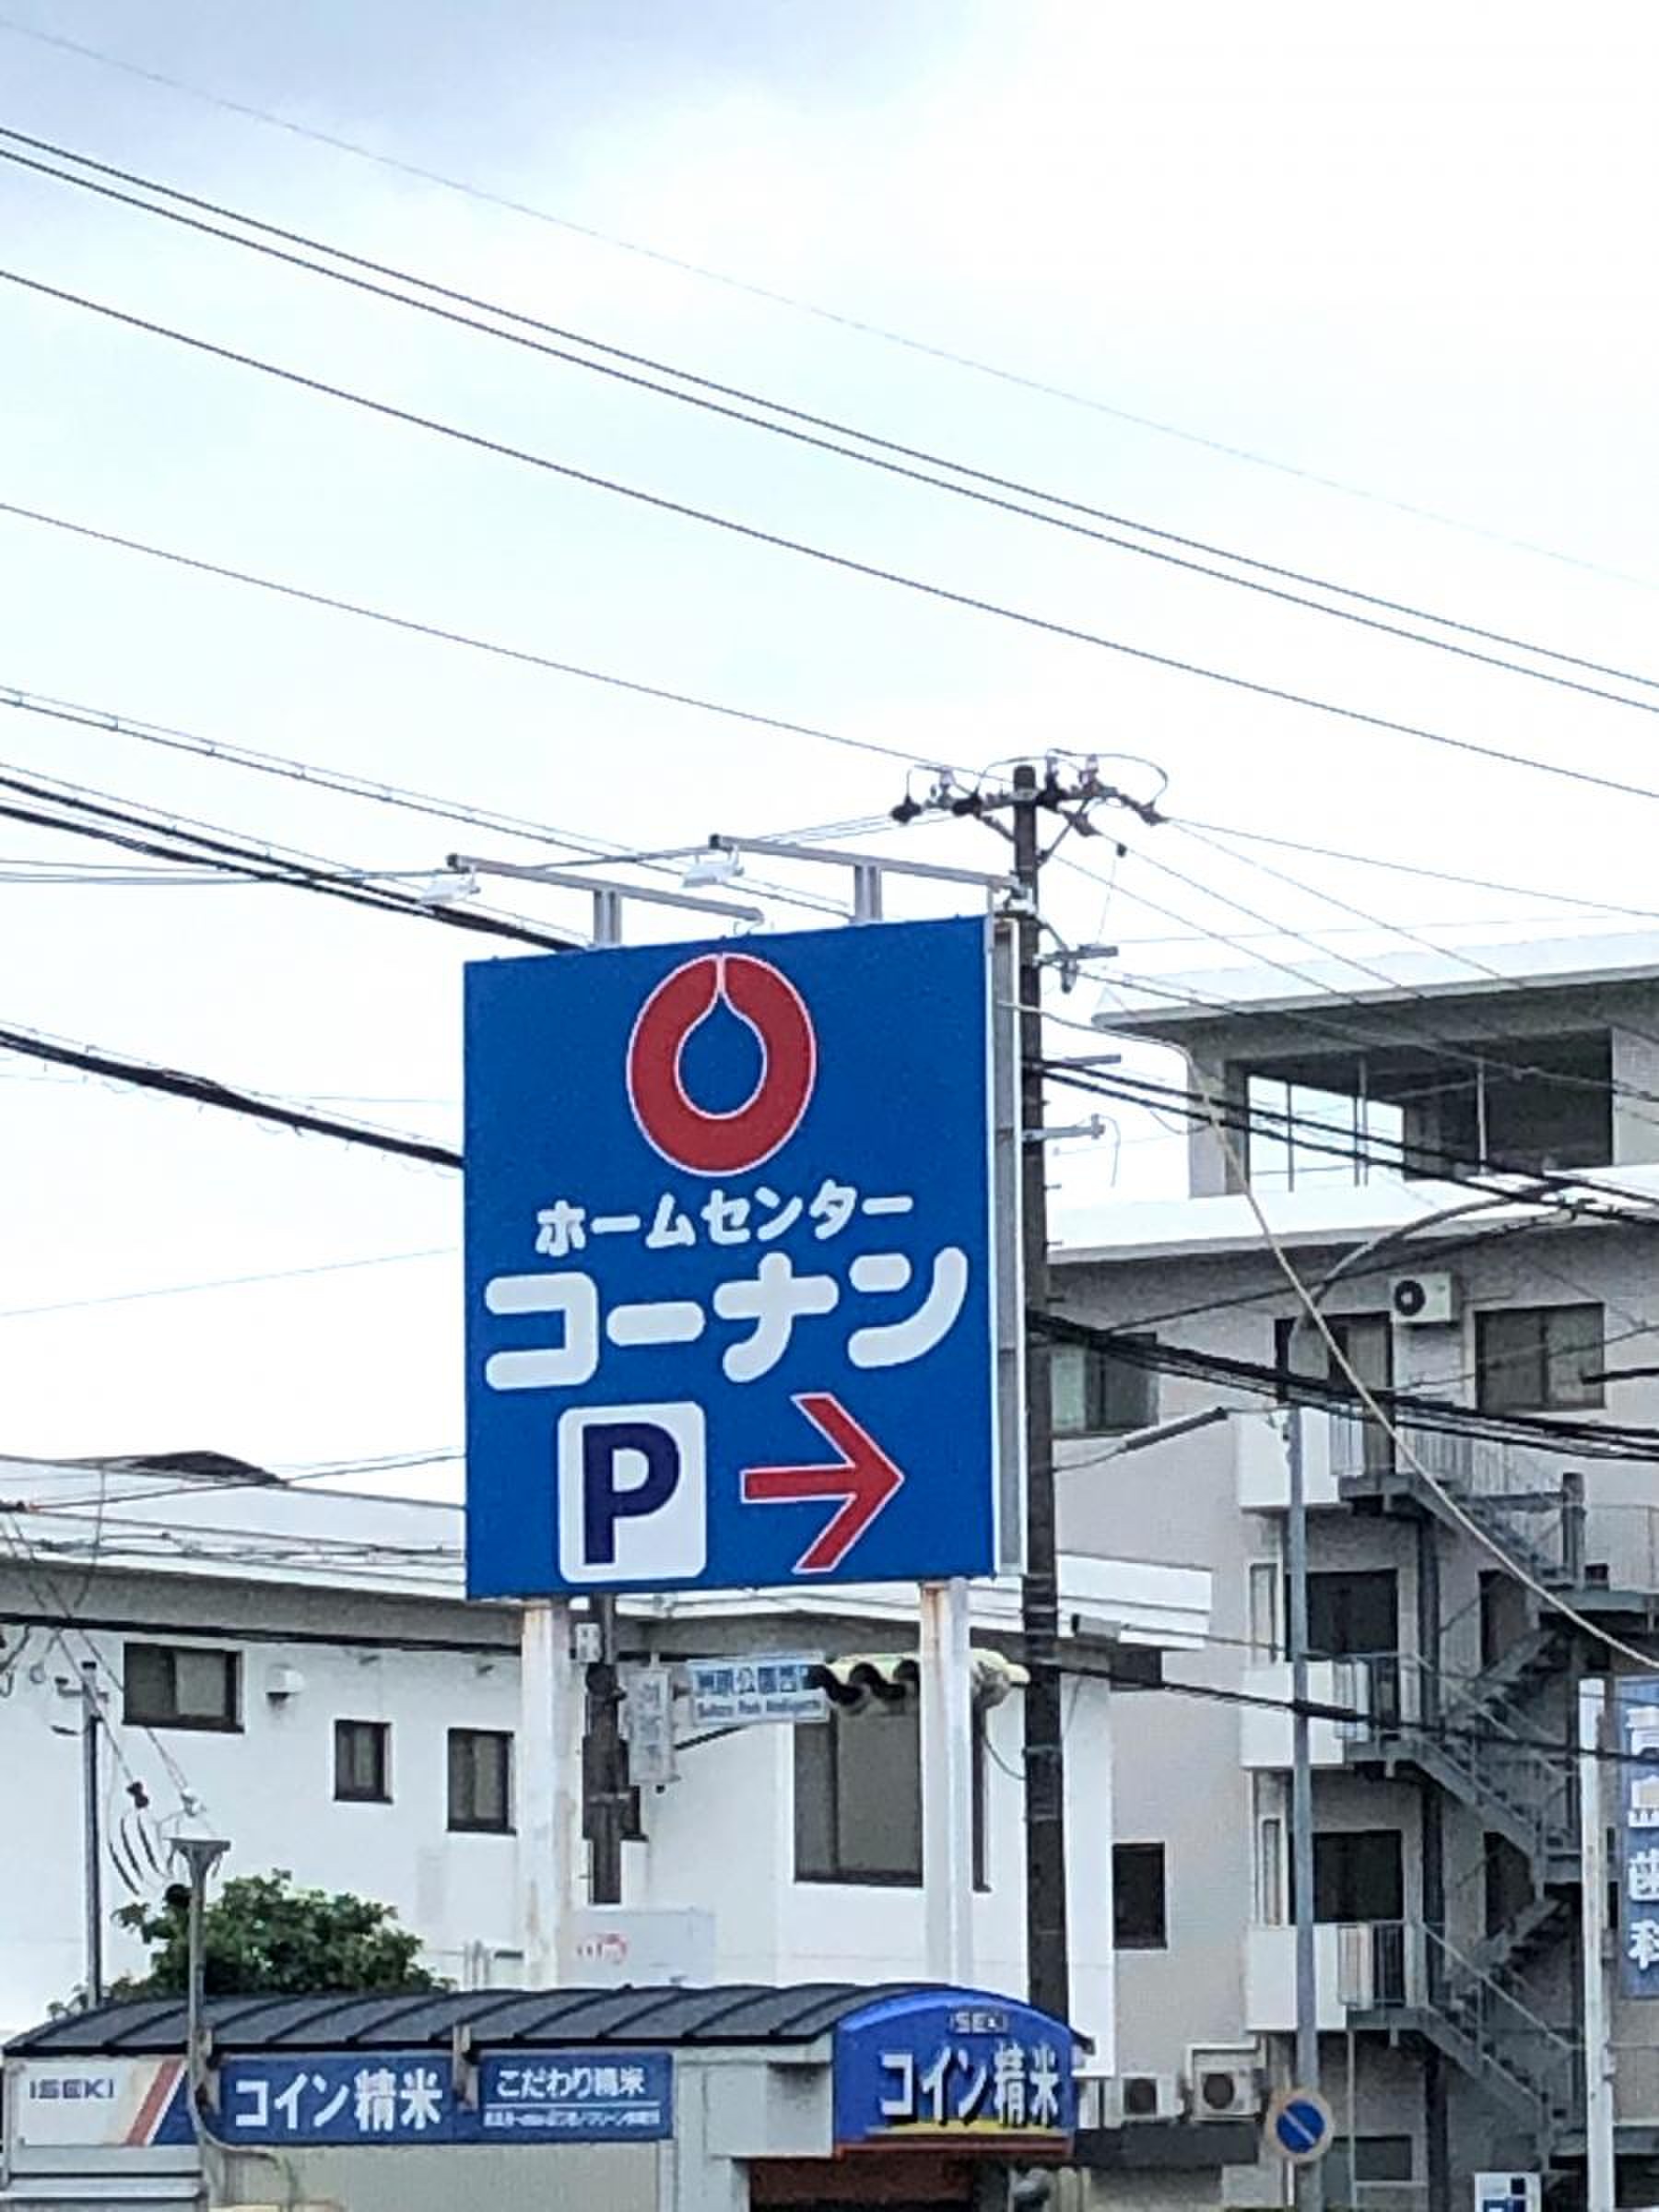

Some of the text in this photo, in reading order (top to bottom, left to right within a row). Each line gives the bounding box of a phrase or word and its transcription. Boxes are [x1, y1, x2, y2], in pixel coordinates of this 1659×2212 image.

[535, 1179, 914, 1256] ホームセンター
[485, 1246, 970, 1391] コーナン
[582, 1422, 681, 1566] P
[29, 2078, 114, 2100] ISEKI
[235, 2067, 443, 2133] コイン精米
[879, 2039, 1059, 2125] コイン精米
